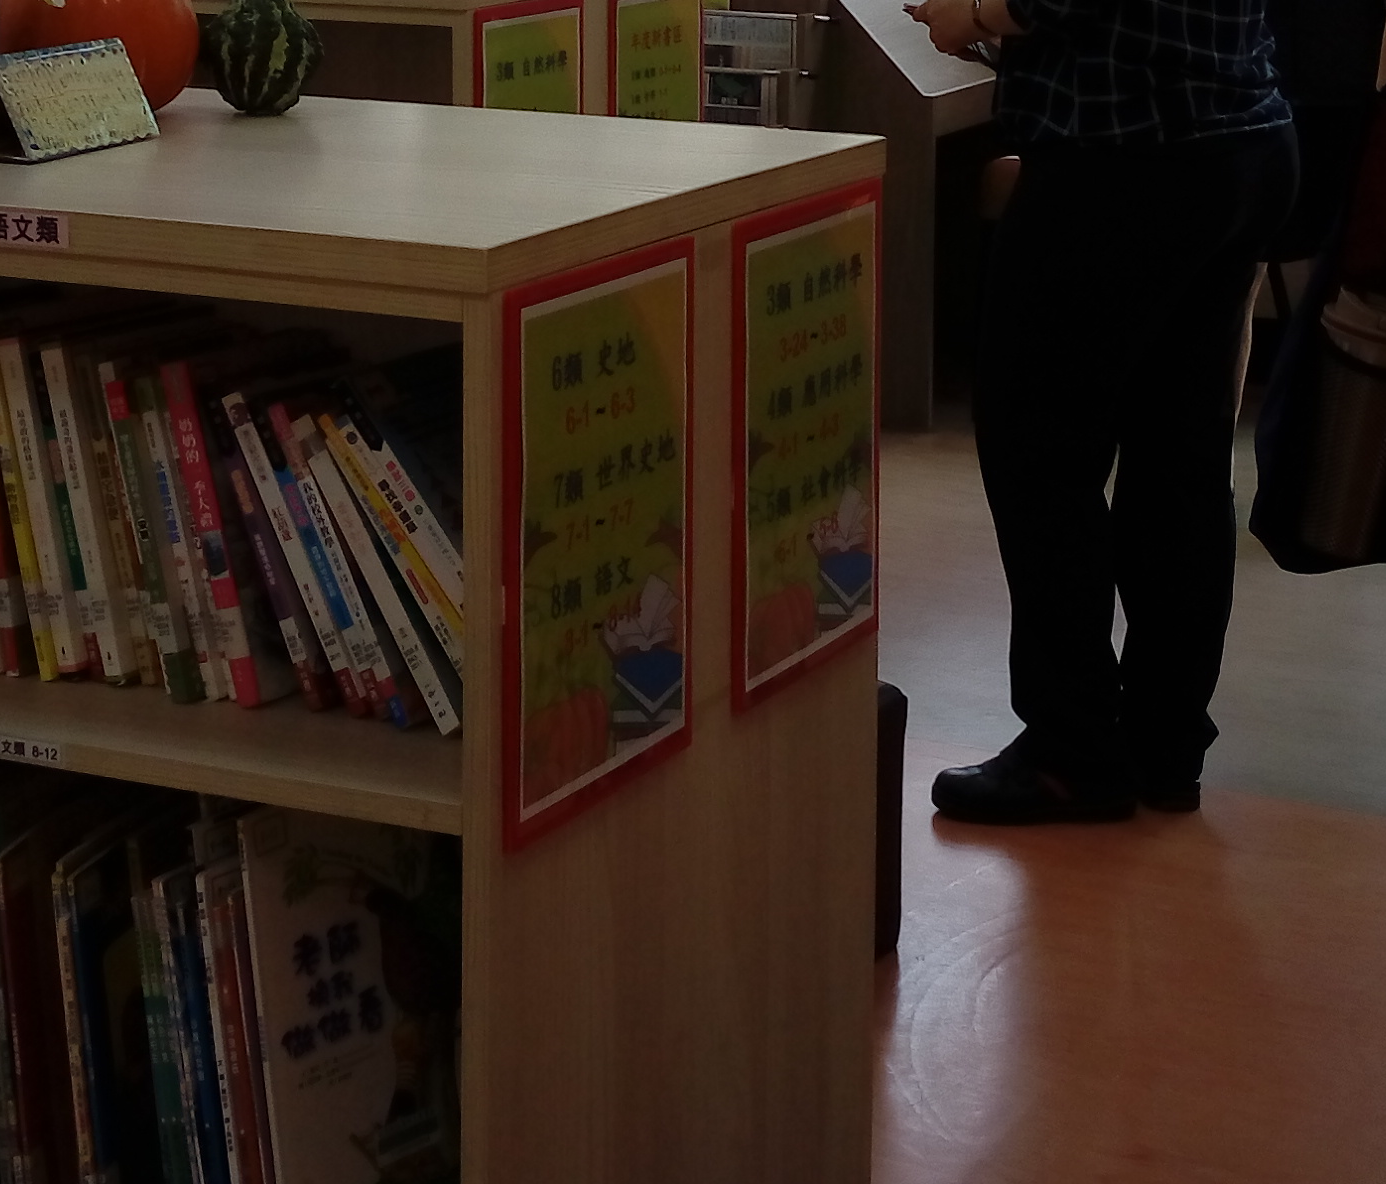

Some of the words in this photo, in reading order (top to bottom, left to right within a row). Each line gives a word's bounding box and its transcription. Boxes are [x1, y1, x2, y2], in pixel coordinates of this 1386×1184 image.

[766, 281, 791, 316] 3類
[803, 253, 862, 302] 自然科學
[552, 351, 583, 392] 6類
[597, 331, 636, 378] 史地
[802, 352, 863, 408] 應用科學
[565, 400, 590, 435] 6-1
[611, 385, 637, 420] 6-3
[553, 468, 584, 508] 7類
[595, 428, 676, 491] 世界史地
[800, 451, 862, 507] 社會科學
[550, 576, 583, 621] 8類
[595, 555, 634, 597] 語文
[32, 745, 58, 761] 8-12
